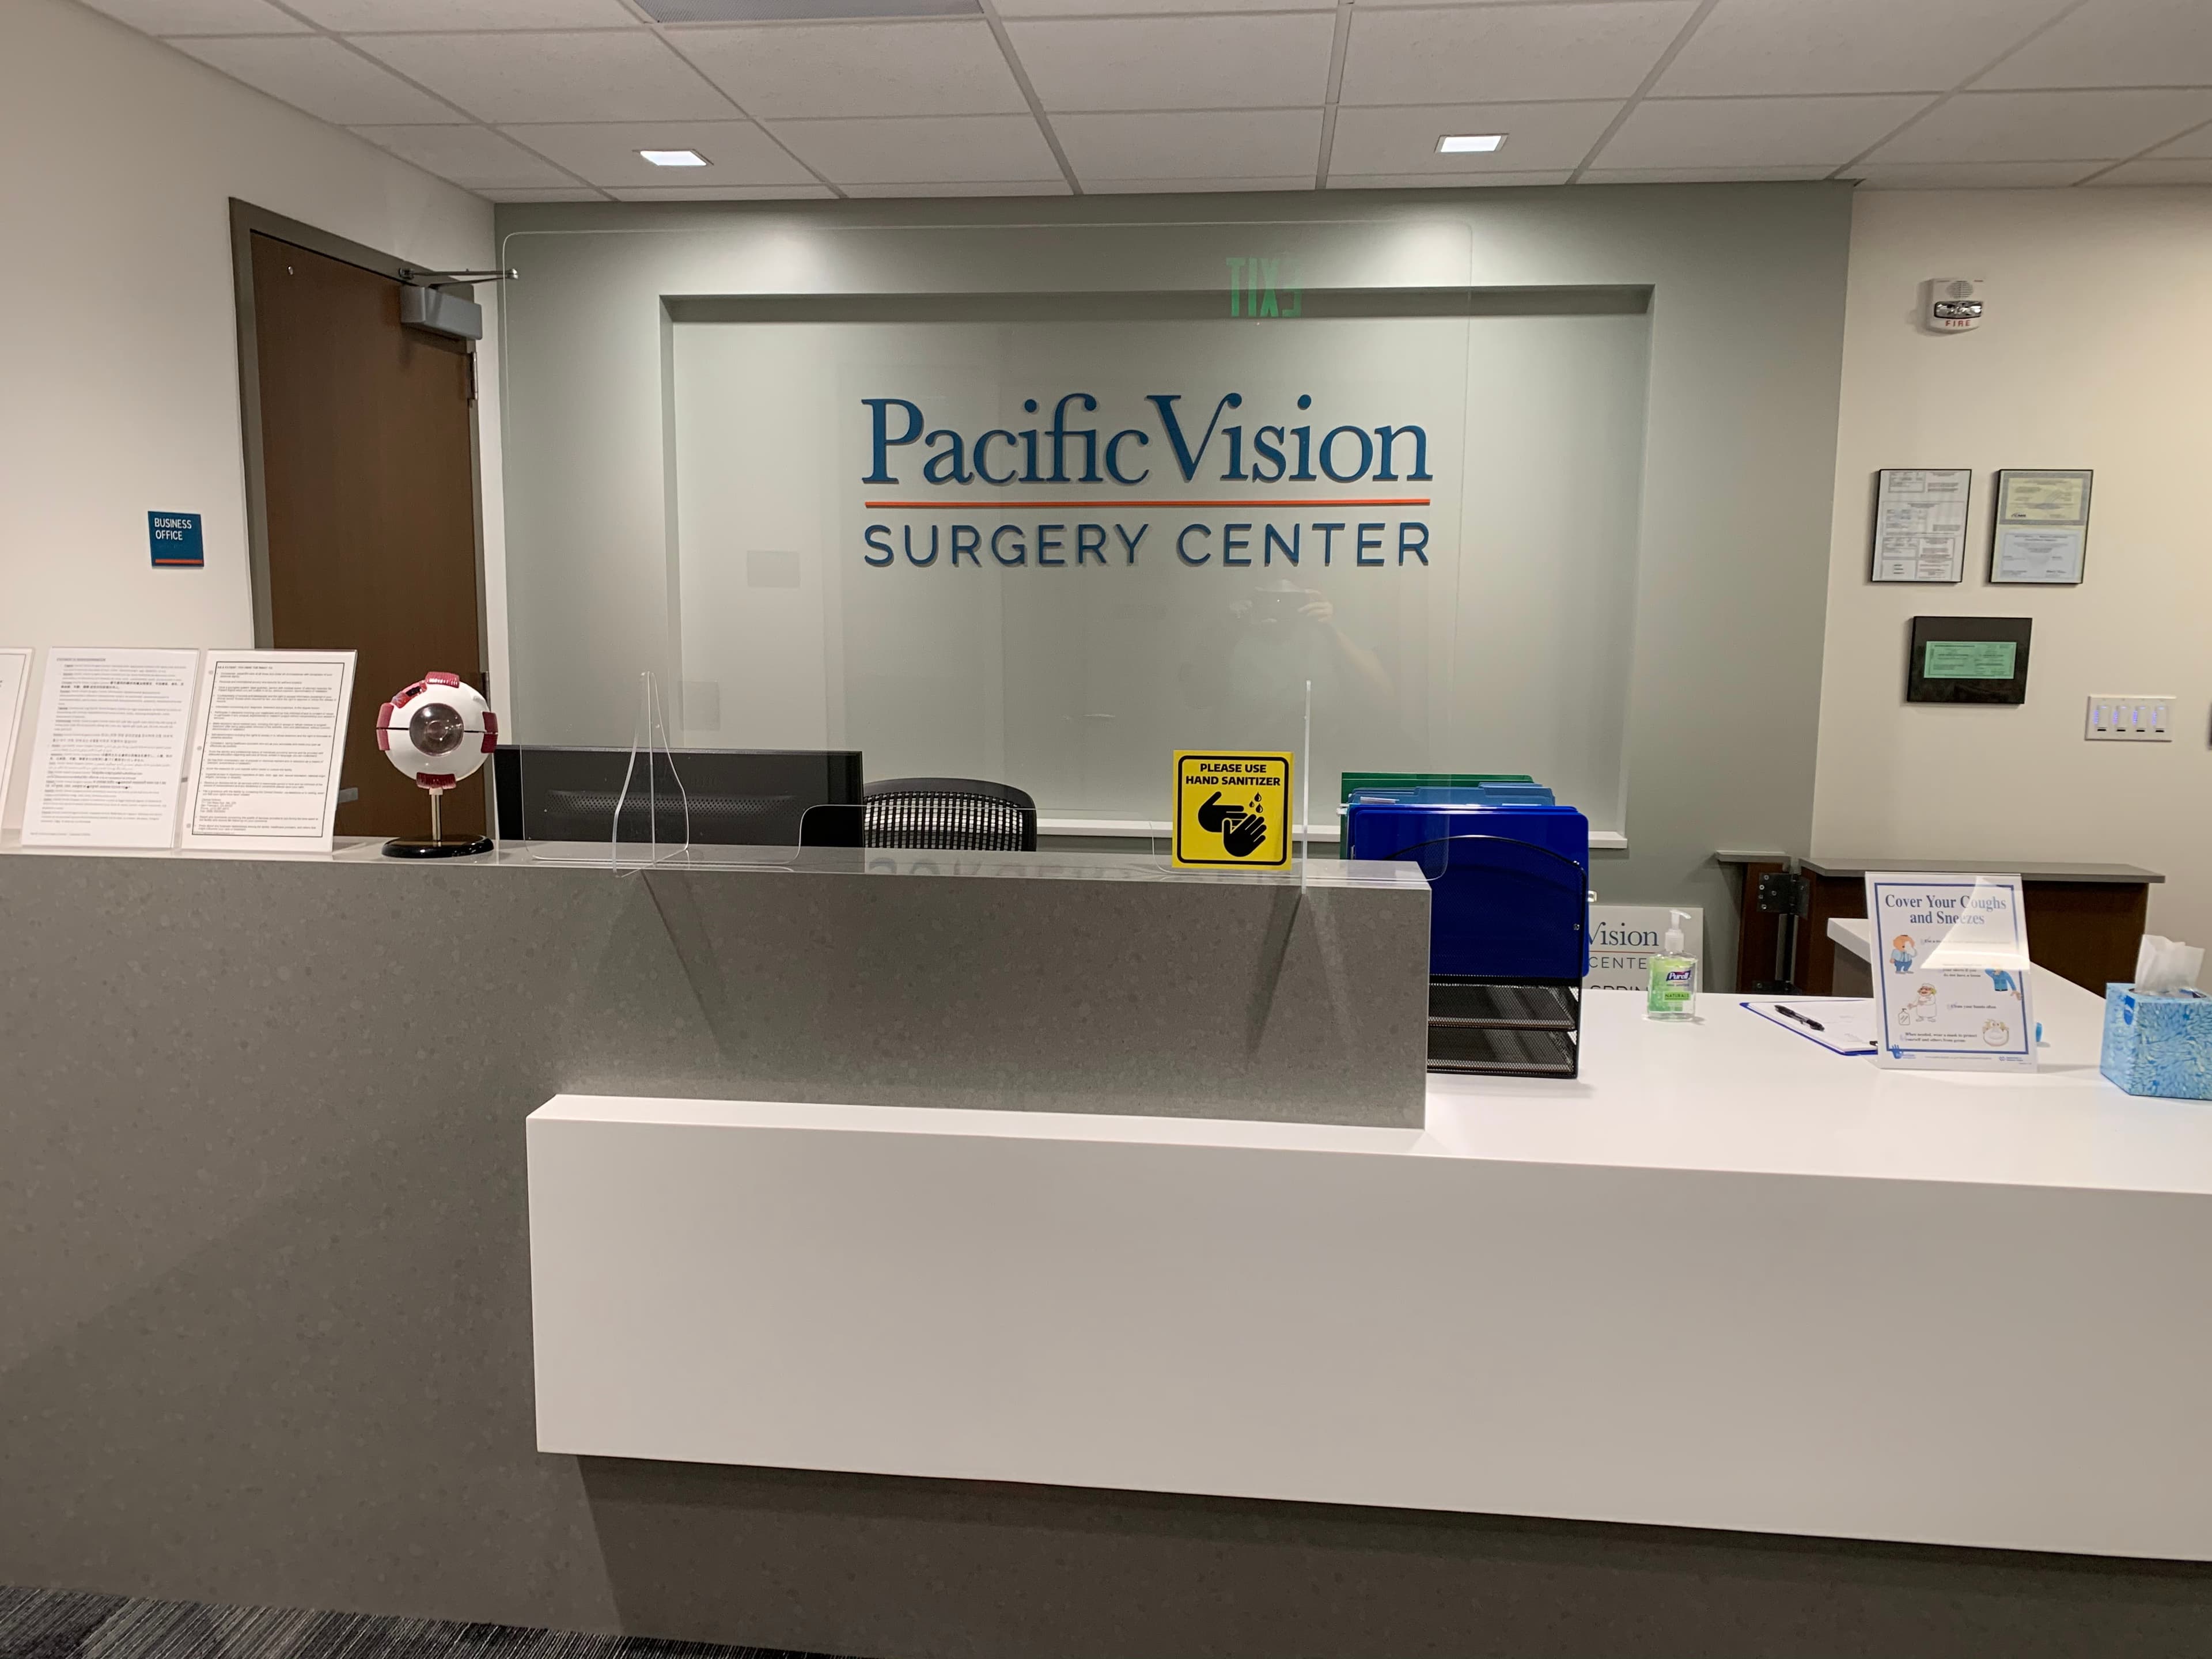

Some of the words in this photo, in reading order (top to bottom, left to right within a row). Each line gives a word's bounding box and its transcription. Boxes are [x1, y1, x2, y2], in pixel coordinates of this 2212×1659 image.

[154, 517, 192, 529] BUSINESS
[156, 530, 183, 540] OFFICE
[863, 523, 1150, 567] SURGERY
[1176, 522, 1431, 567] CENTER
[1200, 763, 1242, 772] PLEASE
[1245, 764, 1267, 773] USE
[1185, 776, 1219, 785] HAND
[1222, 777, 1281, 786] SANITIZER
[1885, 894, 1922, 908] Cover
[1926, 895, 1956, 908] Your
[1960, 895, 2006, 911] Coughs
[1910, 911, 1932, 924] and
[1937, 911, 1985, 925] Sneezes
[1589, 956, 1647, 969] CENTE
